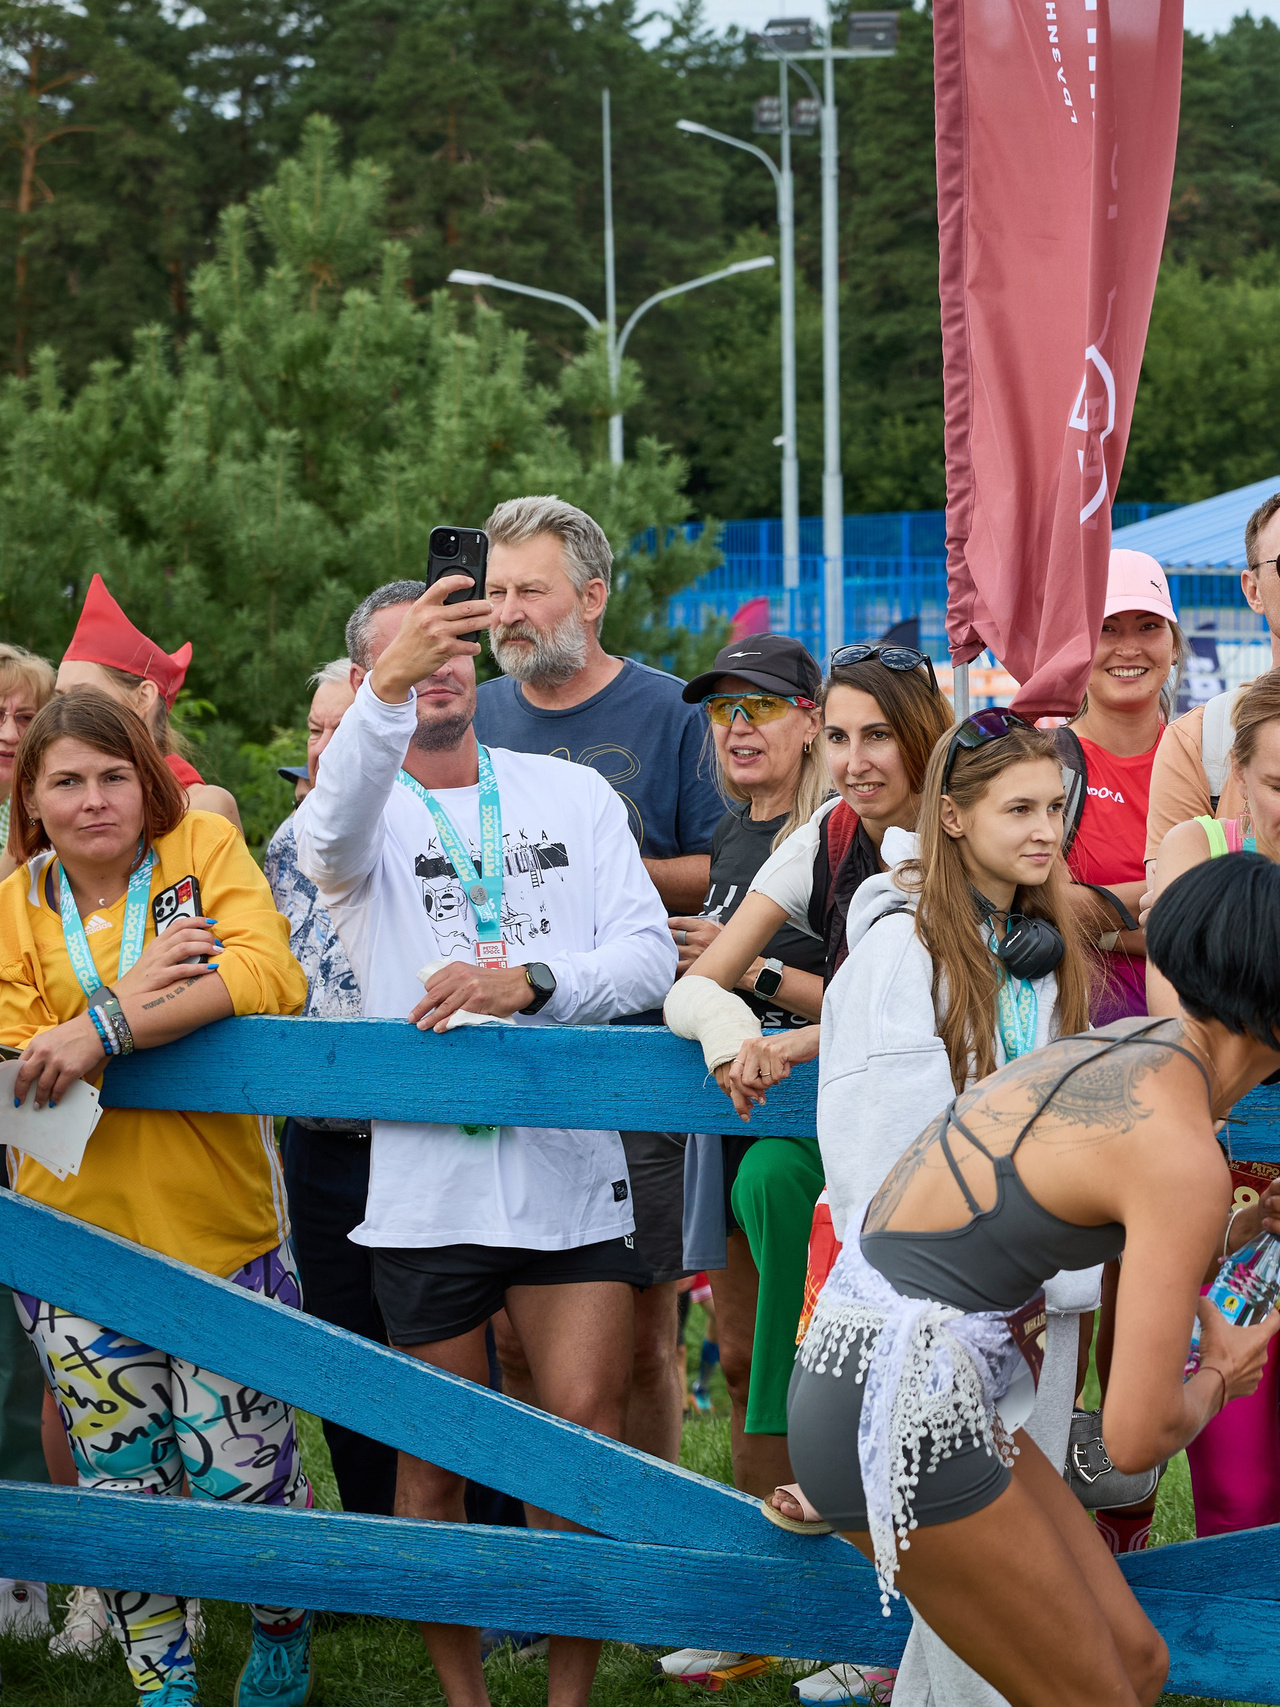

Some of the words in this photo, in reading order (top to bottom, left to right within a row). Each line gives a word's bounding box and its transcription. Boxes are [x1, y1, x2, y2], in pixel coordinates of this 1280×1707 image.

[481, 804, 494, 840] КРОСС
[483, 841, 495, 877] РЕТРО
[124, 902, 140, 940] КРОСС
[66, 931, 86, 969] КРОСС
[1251, 1162, 1280, 1176] РЕТРО
